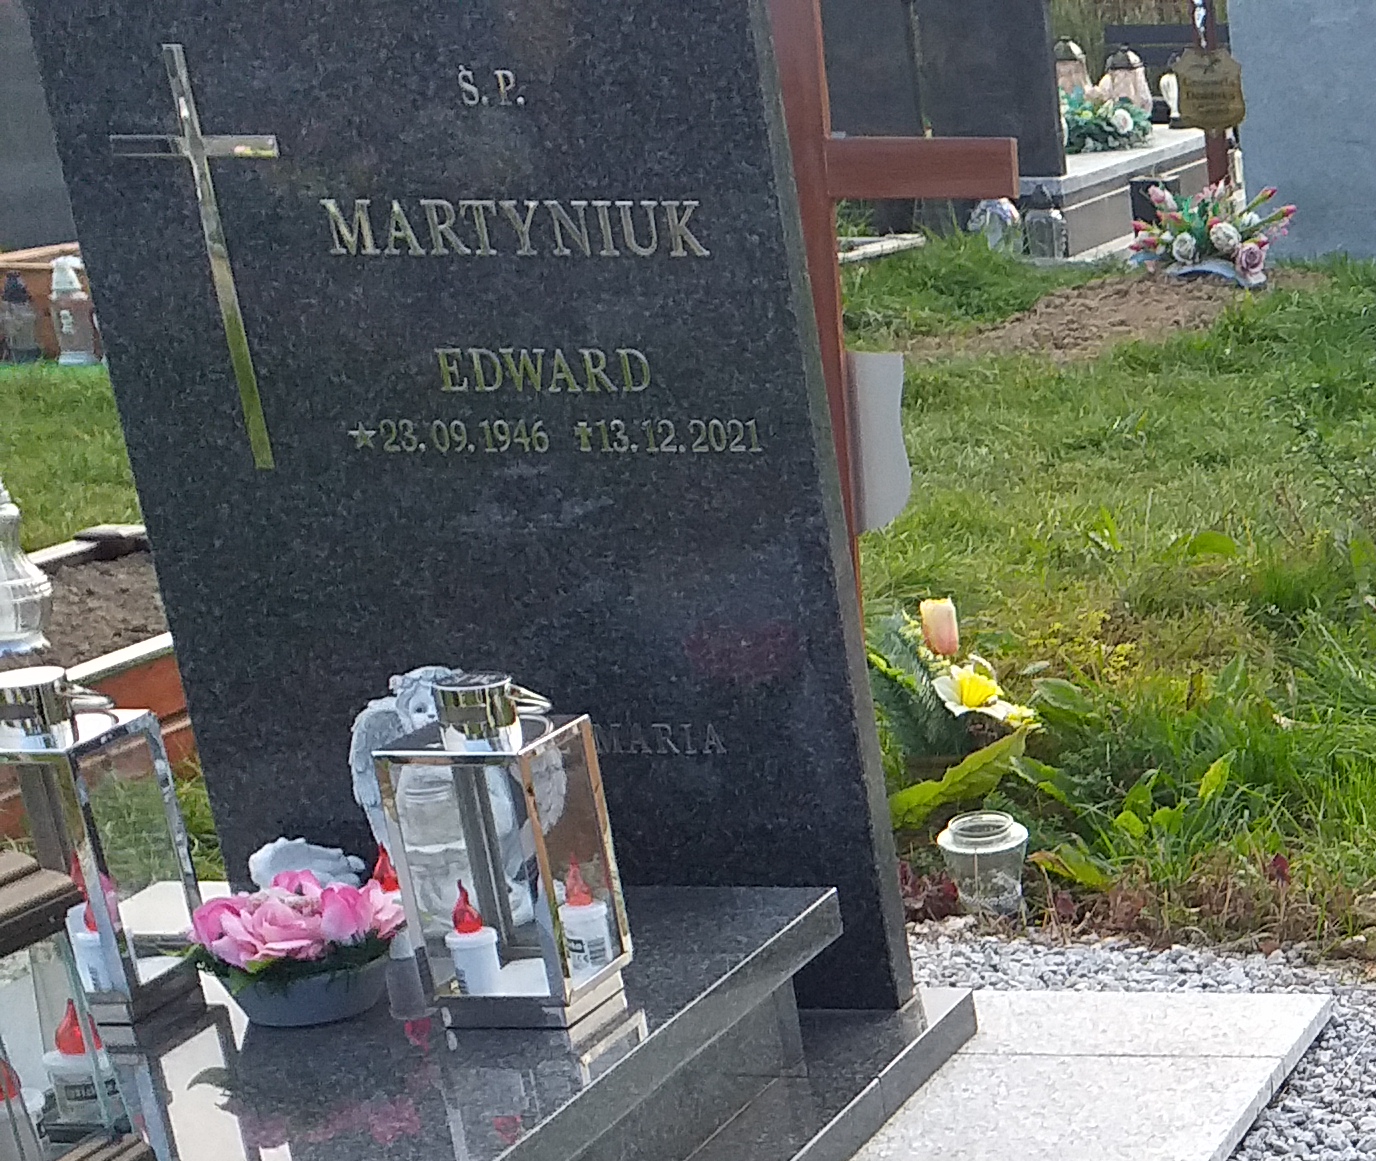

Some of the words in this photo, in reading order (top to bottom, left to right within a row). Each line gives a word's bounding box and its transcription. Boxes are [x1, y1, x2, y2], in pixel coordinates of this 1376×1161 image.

[319, 199, 711, 258] MARTYNIUK
[434, 347, 652, 393] EDWARD
[379, 418, 550, 455] 23.09.1946
[596, 418, 762, 455] 13.12.2021
[594, 722, 728, 755] MARIA
